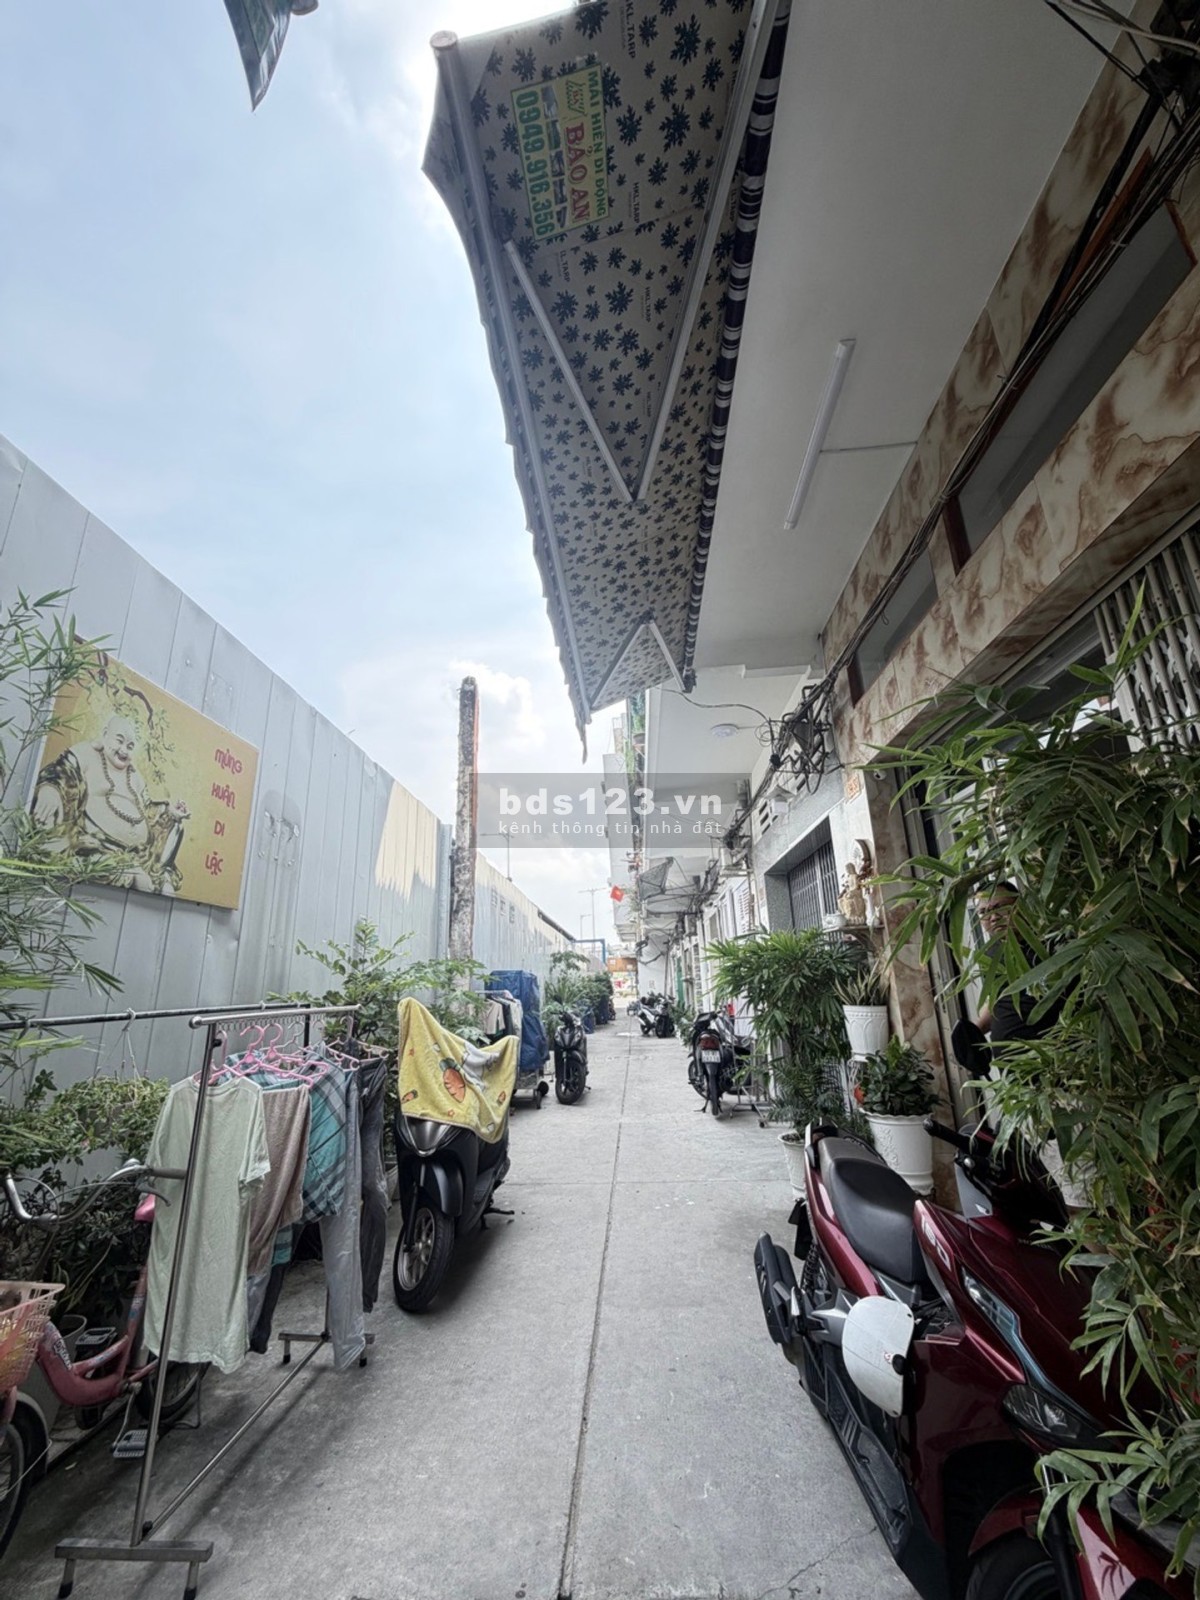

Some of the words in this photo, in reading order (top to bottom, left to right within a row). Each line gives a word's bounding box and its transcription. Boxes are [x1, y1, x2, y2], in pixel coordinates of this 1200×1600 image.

[625, 0, 636, 59] KL.TARP
[516, 90, 555, 236] 0949.916.356
[565, 122, 593, 183] BẢO
[594, 158, 604, 174] DI
[571, 187, 590, 221] AN
